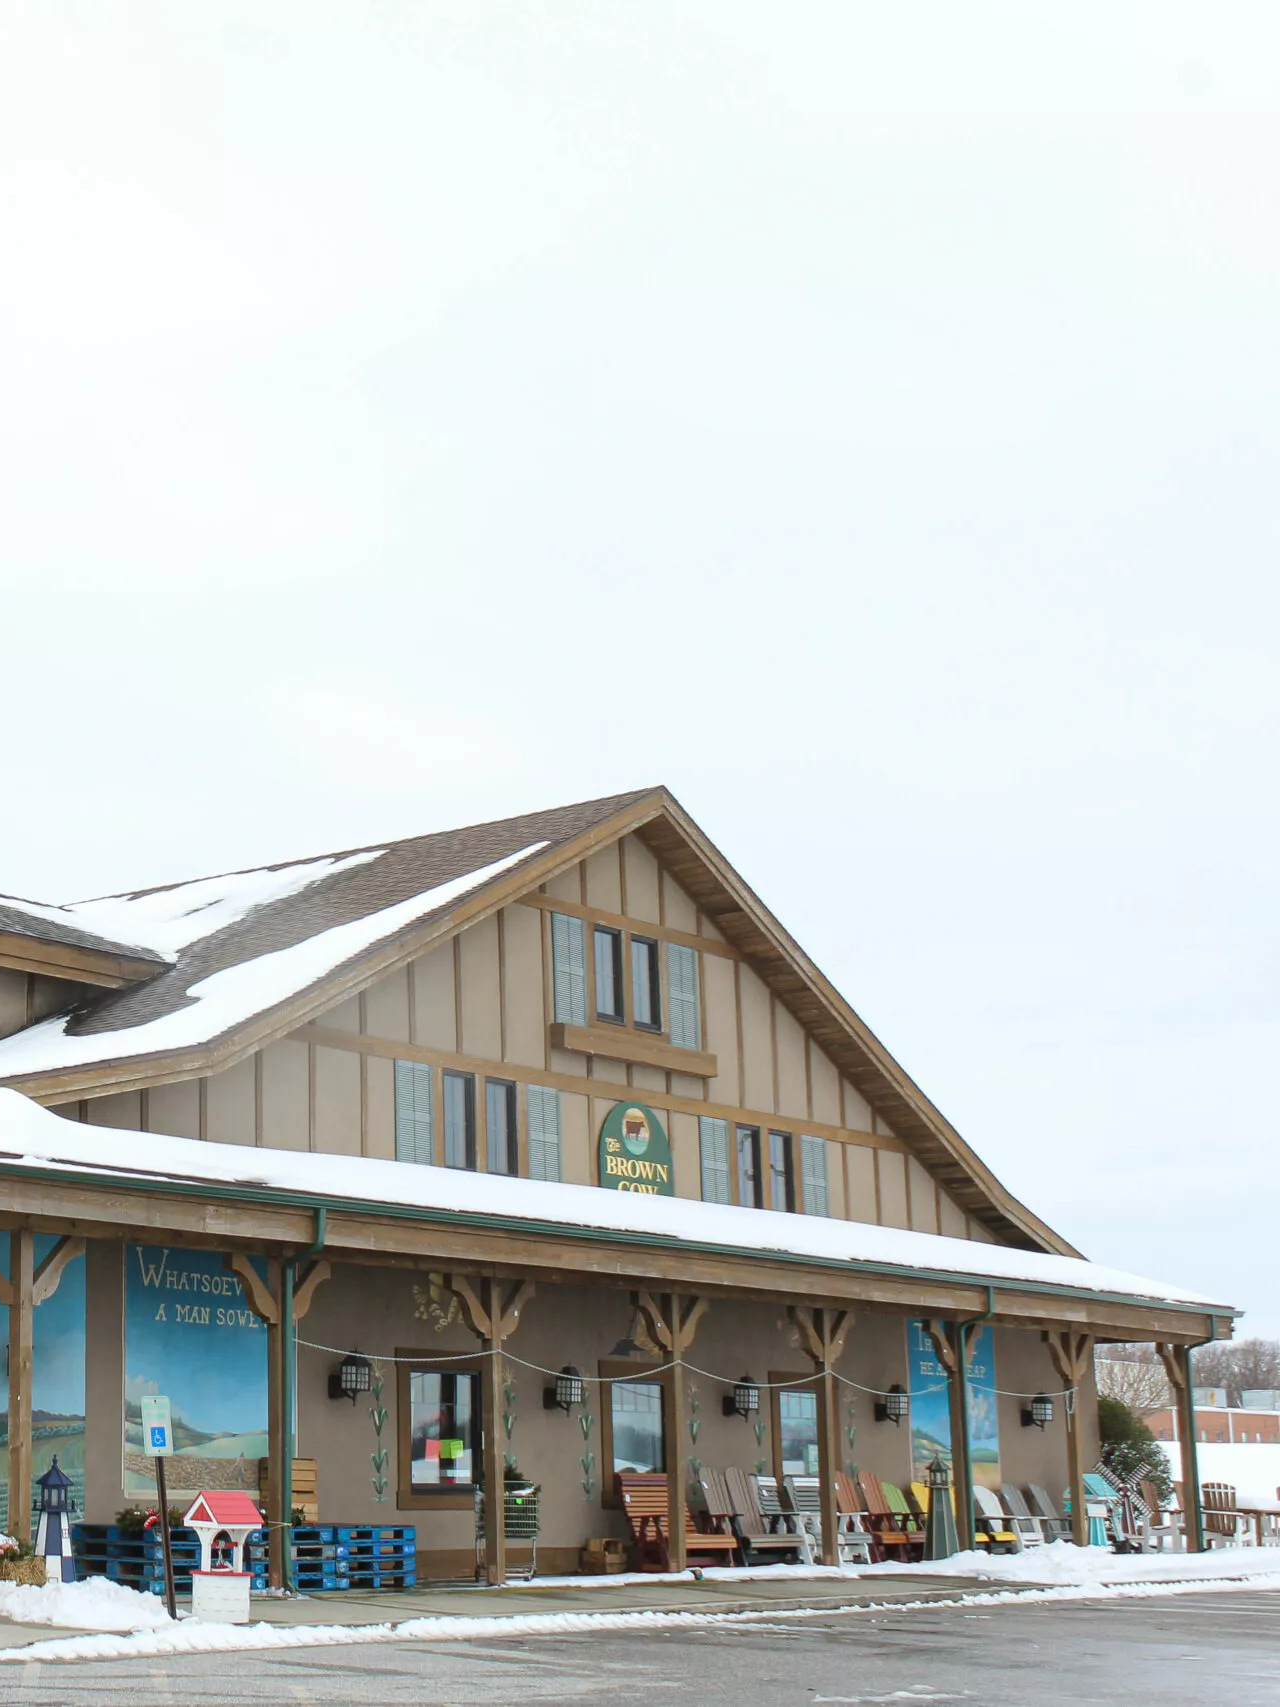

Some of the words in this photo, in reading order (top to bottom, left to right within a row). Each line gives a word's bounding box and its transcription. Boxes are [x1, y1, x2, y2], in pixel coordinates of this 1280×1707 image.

[605, 1154, 669, 1183] BROWN
[618, 1180, 659, 1195] COW
[136, 1246, 243, 1296] WHATSOEV
[155, 1303, 168, 1322] A
[176, 1304, 210, 1325] MAN
